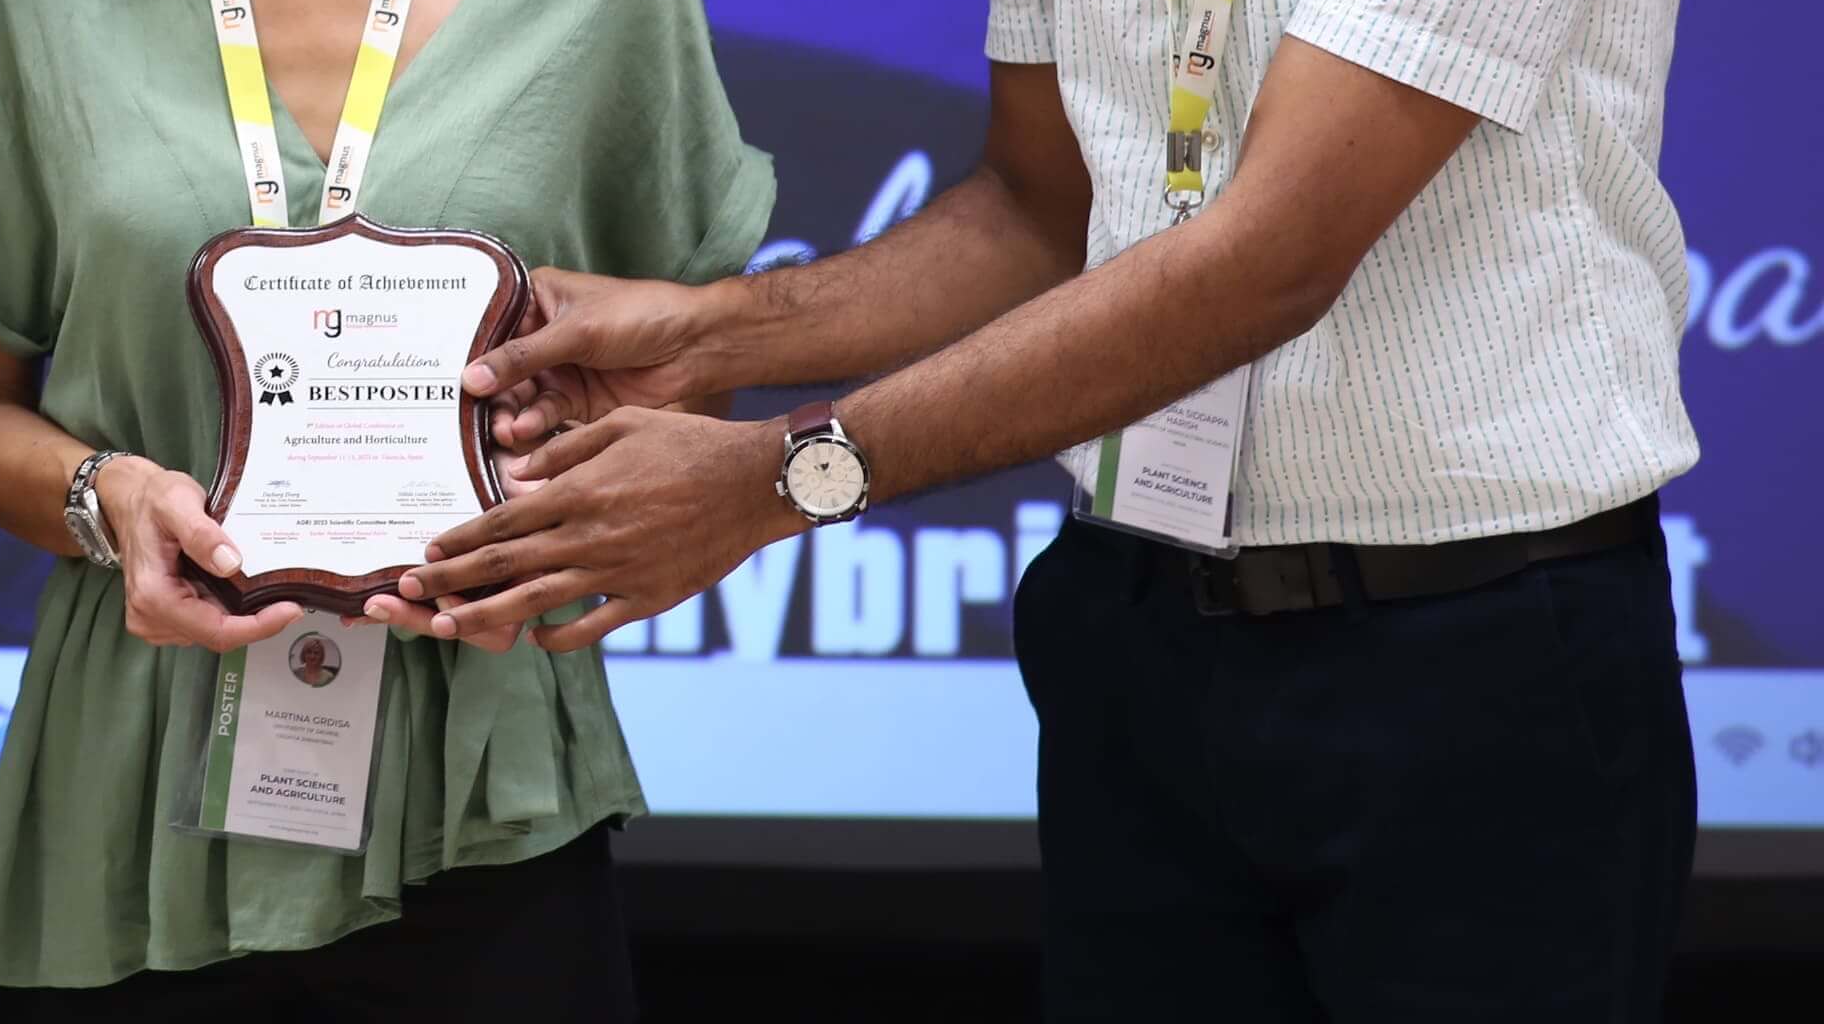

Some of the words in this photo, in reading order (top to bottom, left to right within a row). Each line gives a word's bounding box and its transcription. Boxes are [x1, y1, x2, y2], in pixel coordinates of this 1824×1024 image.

[1195, 9, 1213, 52] magnus
[243, 275, 332, 291] Certificate
[337, 275, 354, 291] of
[359, 274, 467, 291] Achievement
[345, 312, 398, 324] magnus
[327, 352, 441, 370] Congratulations
[308, 385, 455, 402] BESTPOSTER
[284, 435, 341, 446] Agriculture
[344, 435, 361, 444] and
[365, 435, 428, 445] Horticulture
[1142, 466, 1170, 480] PLANT
[1172, 474, 1208, 491] SCIENCE
[1134, 477, 1153, 490] AND
[1154, 482, 1213, 505] AGRICULTURE
[218, 672, 238, 736] POSTER
[265, 710, 310, 724] MARTINA
[261, 774, 293, 787] PLANT
[295, 778, 339, 791] SCIENCE
[250, 784, 273, 796] AND
[275, 788, 346, 806] AGRICULTURE
